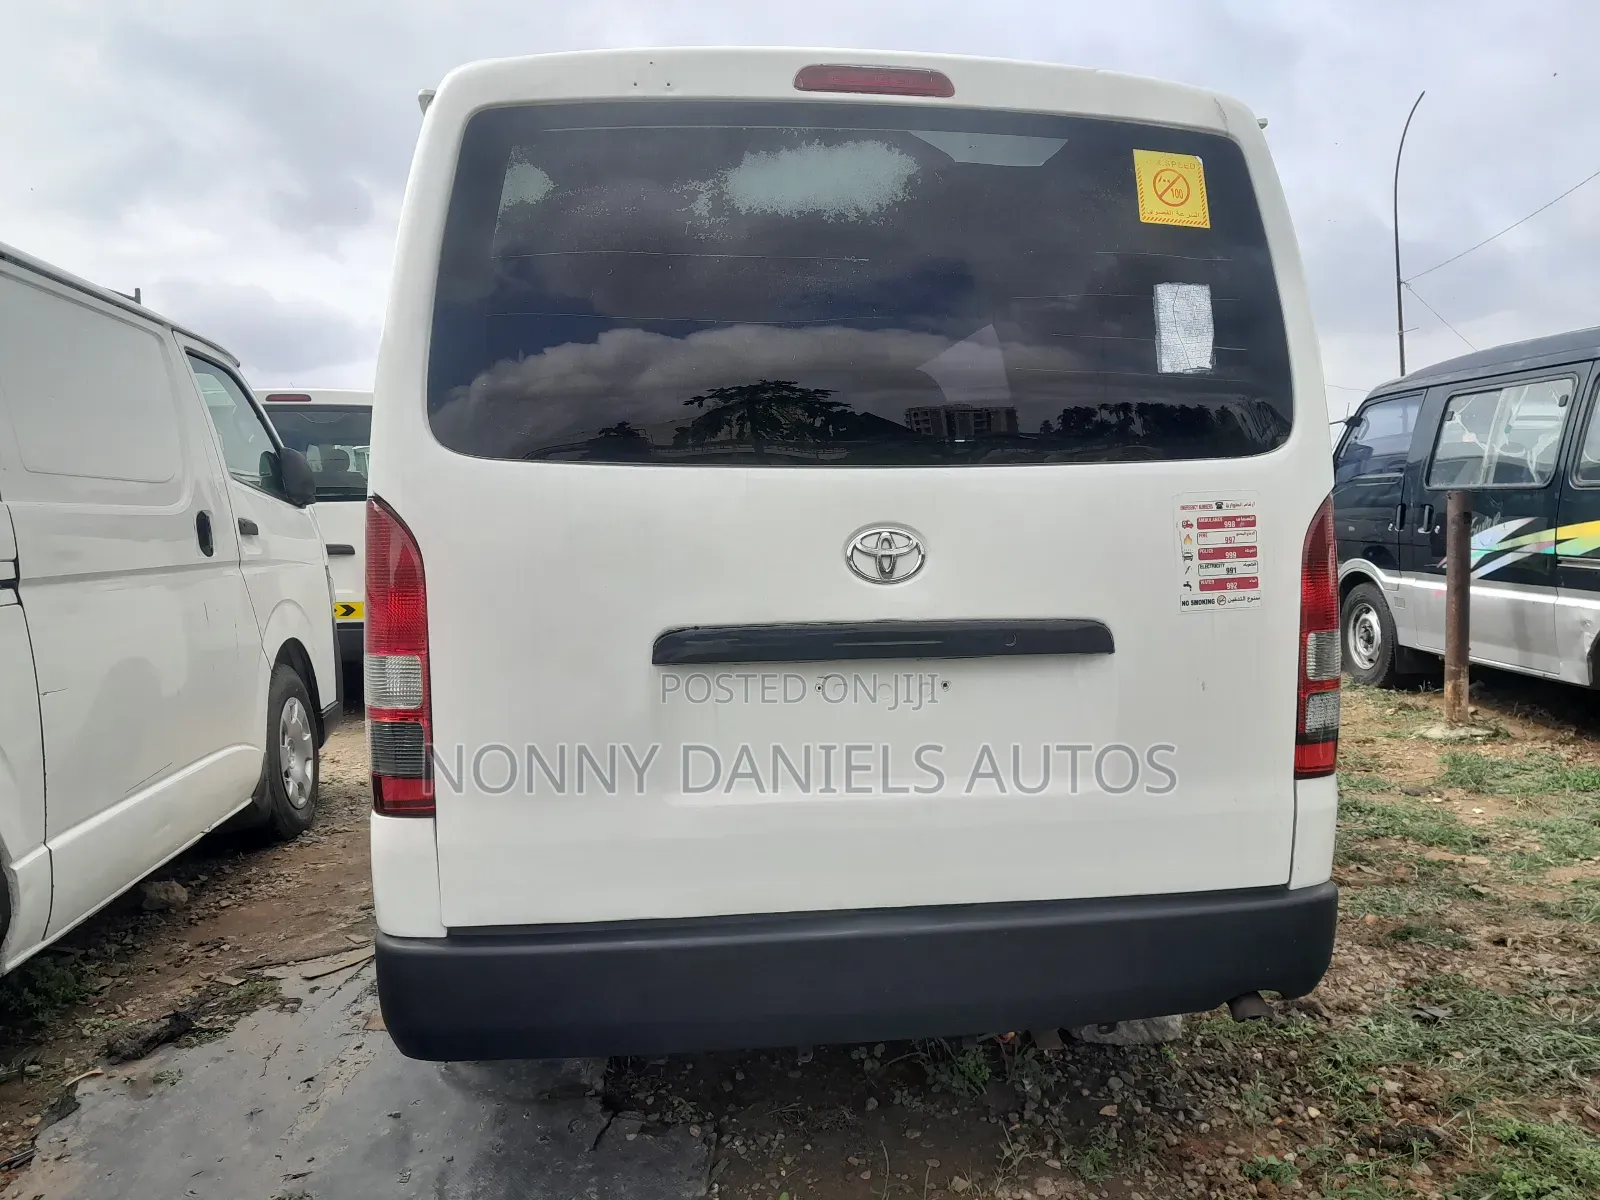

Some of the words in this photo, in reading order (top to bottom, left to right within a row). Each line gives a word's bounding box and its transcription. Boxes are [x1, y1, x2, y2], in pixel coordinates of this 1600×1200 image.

[1170, 188, 1184, 199] 100
[1223, 520, 1236, 528] 998
[1224, 536, 1236, 544] 997
[1225, 551, 1237, 559] 999
[1226, 566, 1237, 575] 991
[1226, 582, 1238, 590] 992
[1190, 598, 1216, 606] SMOKING
